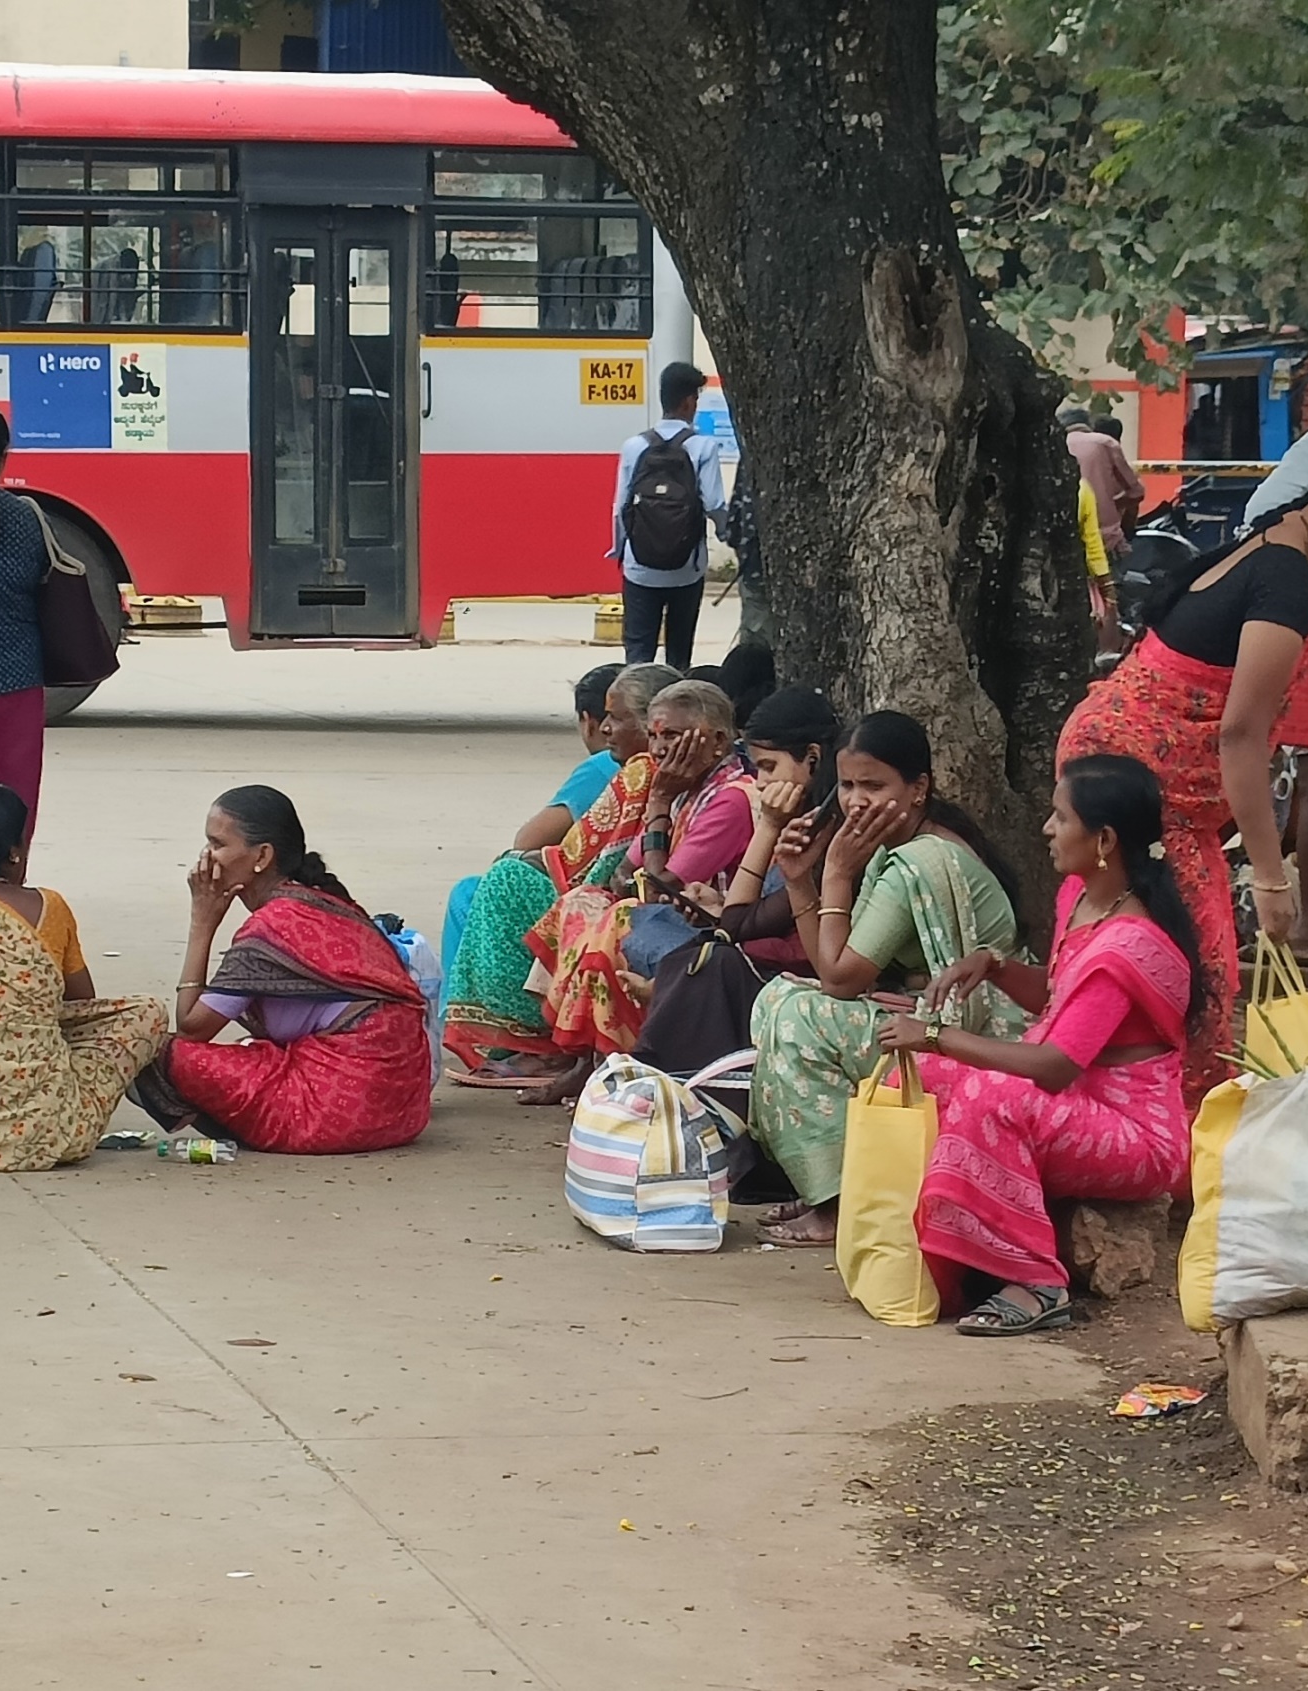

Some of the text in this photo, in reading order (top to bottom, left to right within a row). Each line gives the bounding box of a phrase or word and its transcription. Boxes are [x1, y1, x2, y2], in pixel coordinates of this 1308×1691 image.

[59, 356, 101, 371] Hero
[590, 363, 634, 379] KA-17
[588, 384, 637, 401] F-1634
